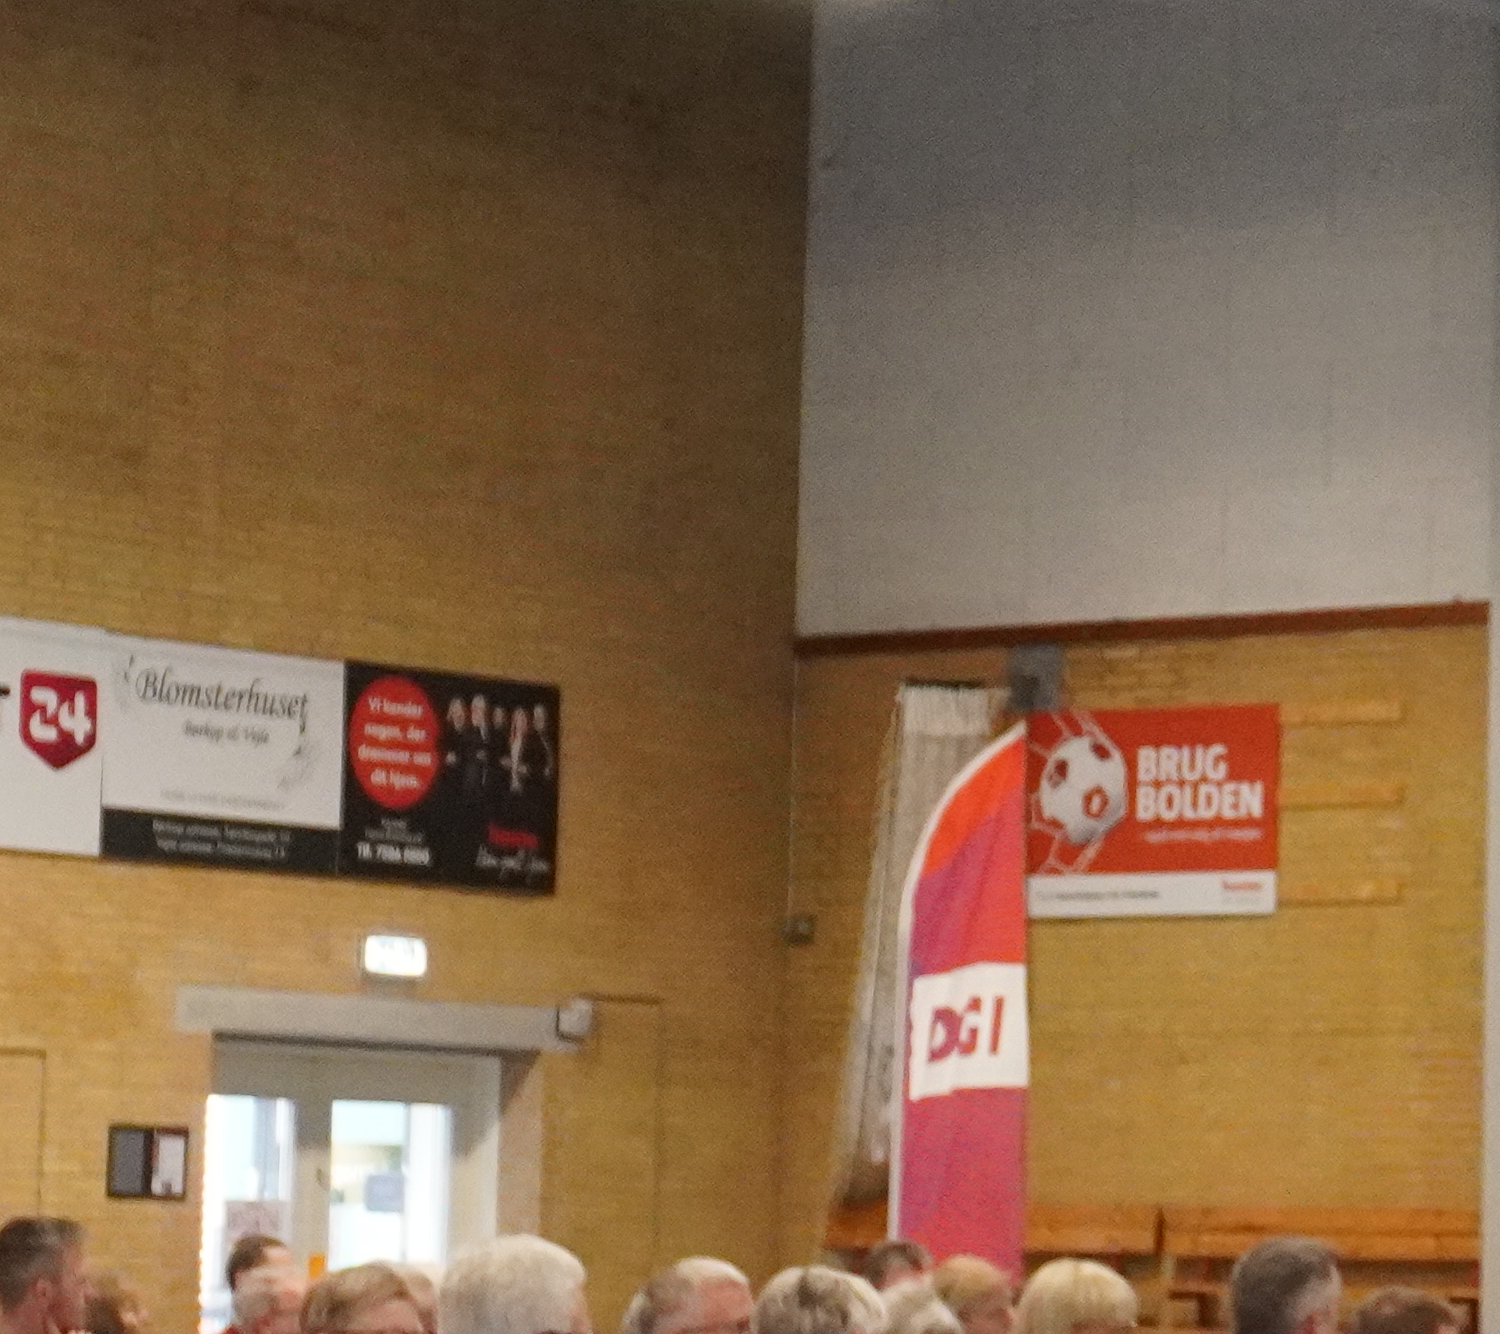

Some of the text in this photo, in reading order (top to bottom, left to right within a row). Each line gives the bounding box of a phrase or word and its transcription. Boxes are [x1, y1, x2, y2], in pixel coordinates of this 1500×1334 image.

[28, 685, 93, 746] 24
[135, 664, 309, 735] Blomsterhuset
[1137, 742, 1229, 782] BRUG
[1136, 781, 1264, 822] BOLDEN
[928, 995, 1007, 1064] DGI
